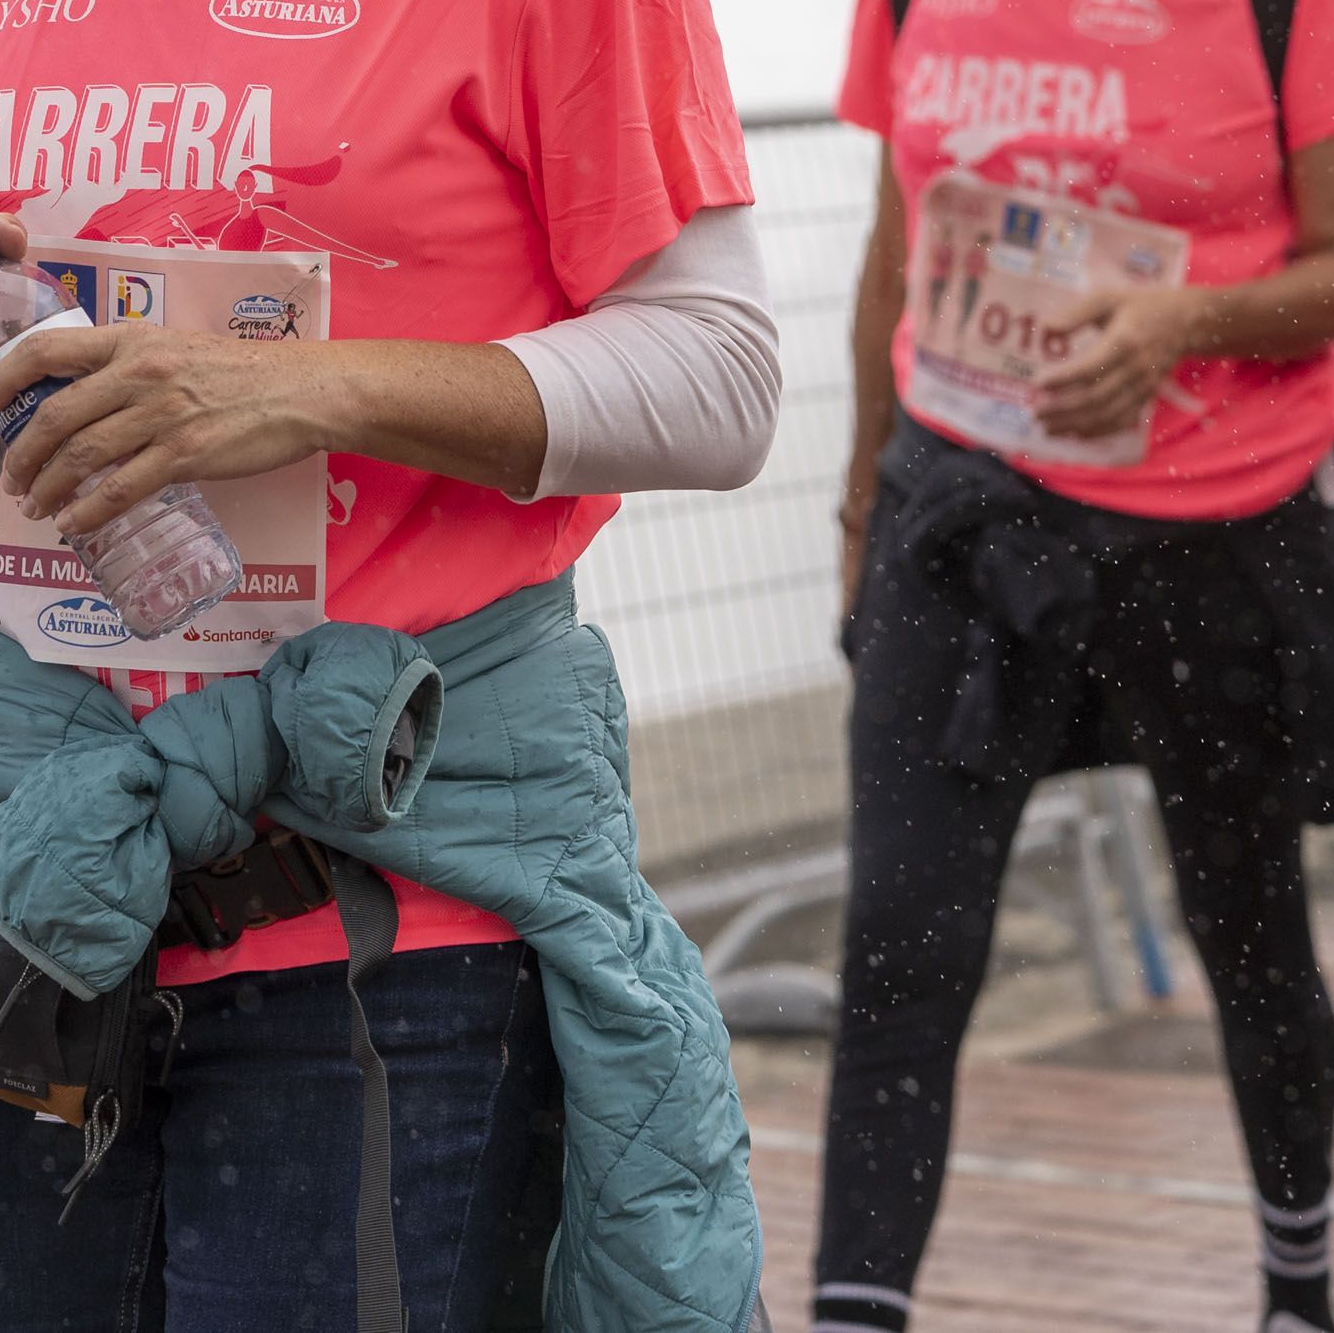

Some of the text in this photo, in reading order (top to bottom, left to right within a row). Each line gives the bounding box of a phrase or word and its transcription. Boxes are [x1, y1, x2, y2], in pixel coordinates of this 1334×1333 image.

[237, 304, 281, 314] ASTURIANA
[228, 317, 272, 332] Carrera
[21, 557, 44, 579] LA
[51, 560, 93, 583] MUJ
[233, 574, 299, 594] NARIA
[60, 611, 90, 620] CENTRAL
[44, 612, 127, 637] ASTURIANA
[202, 628, 275, 643] Santander
